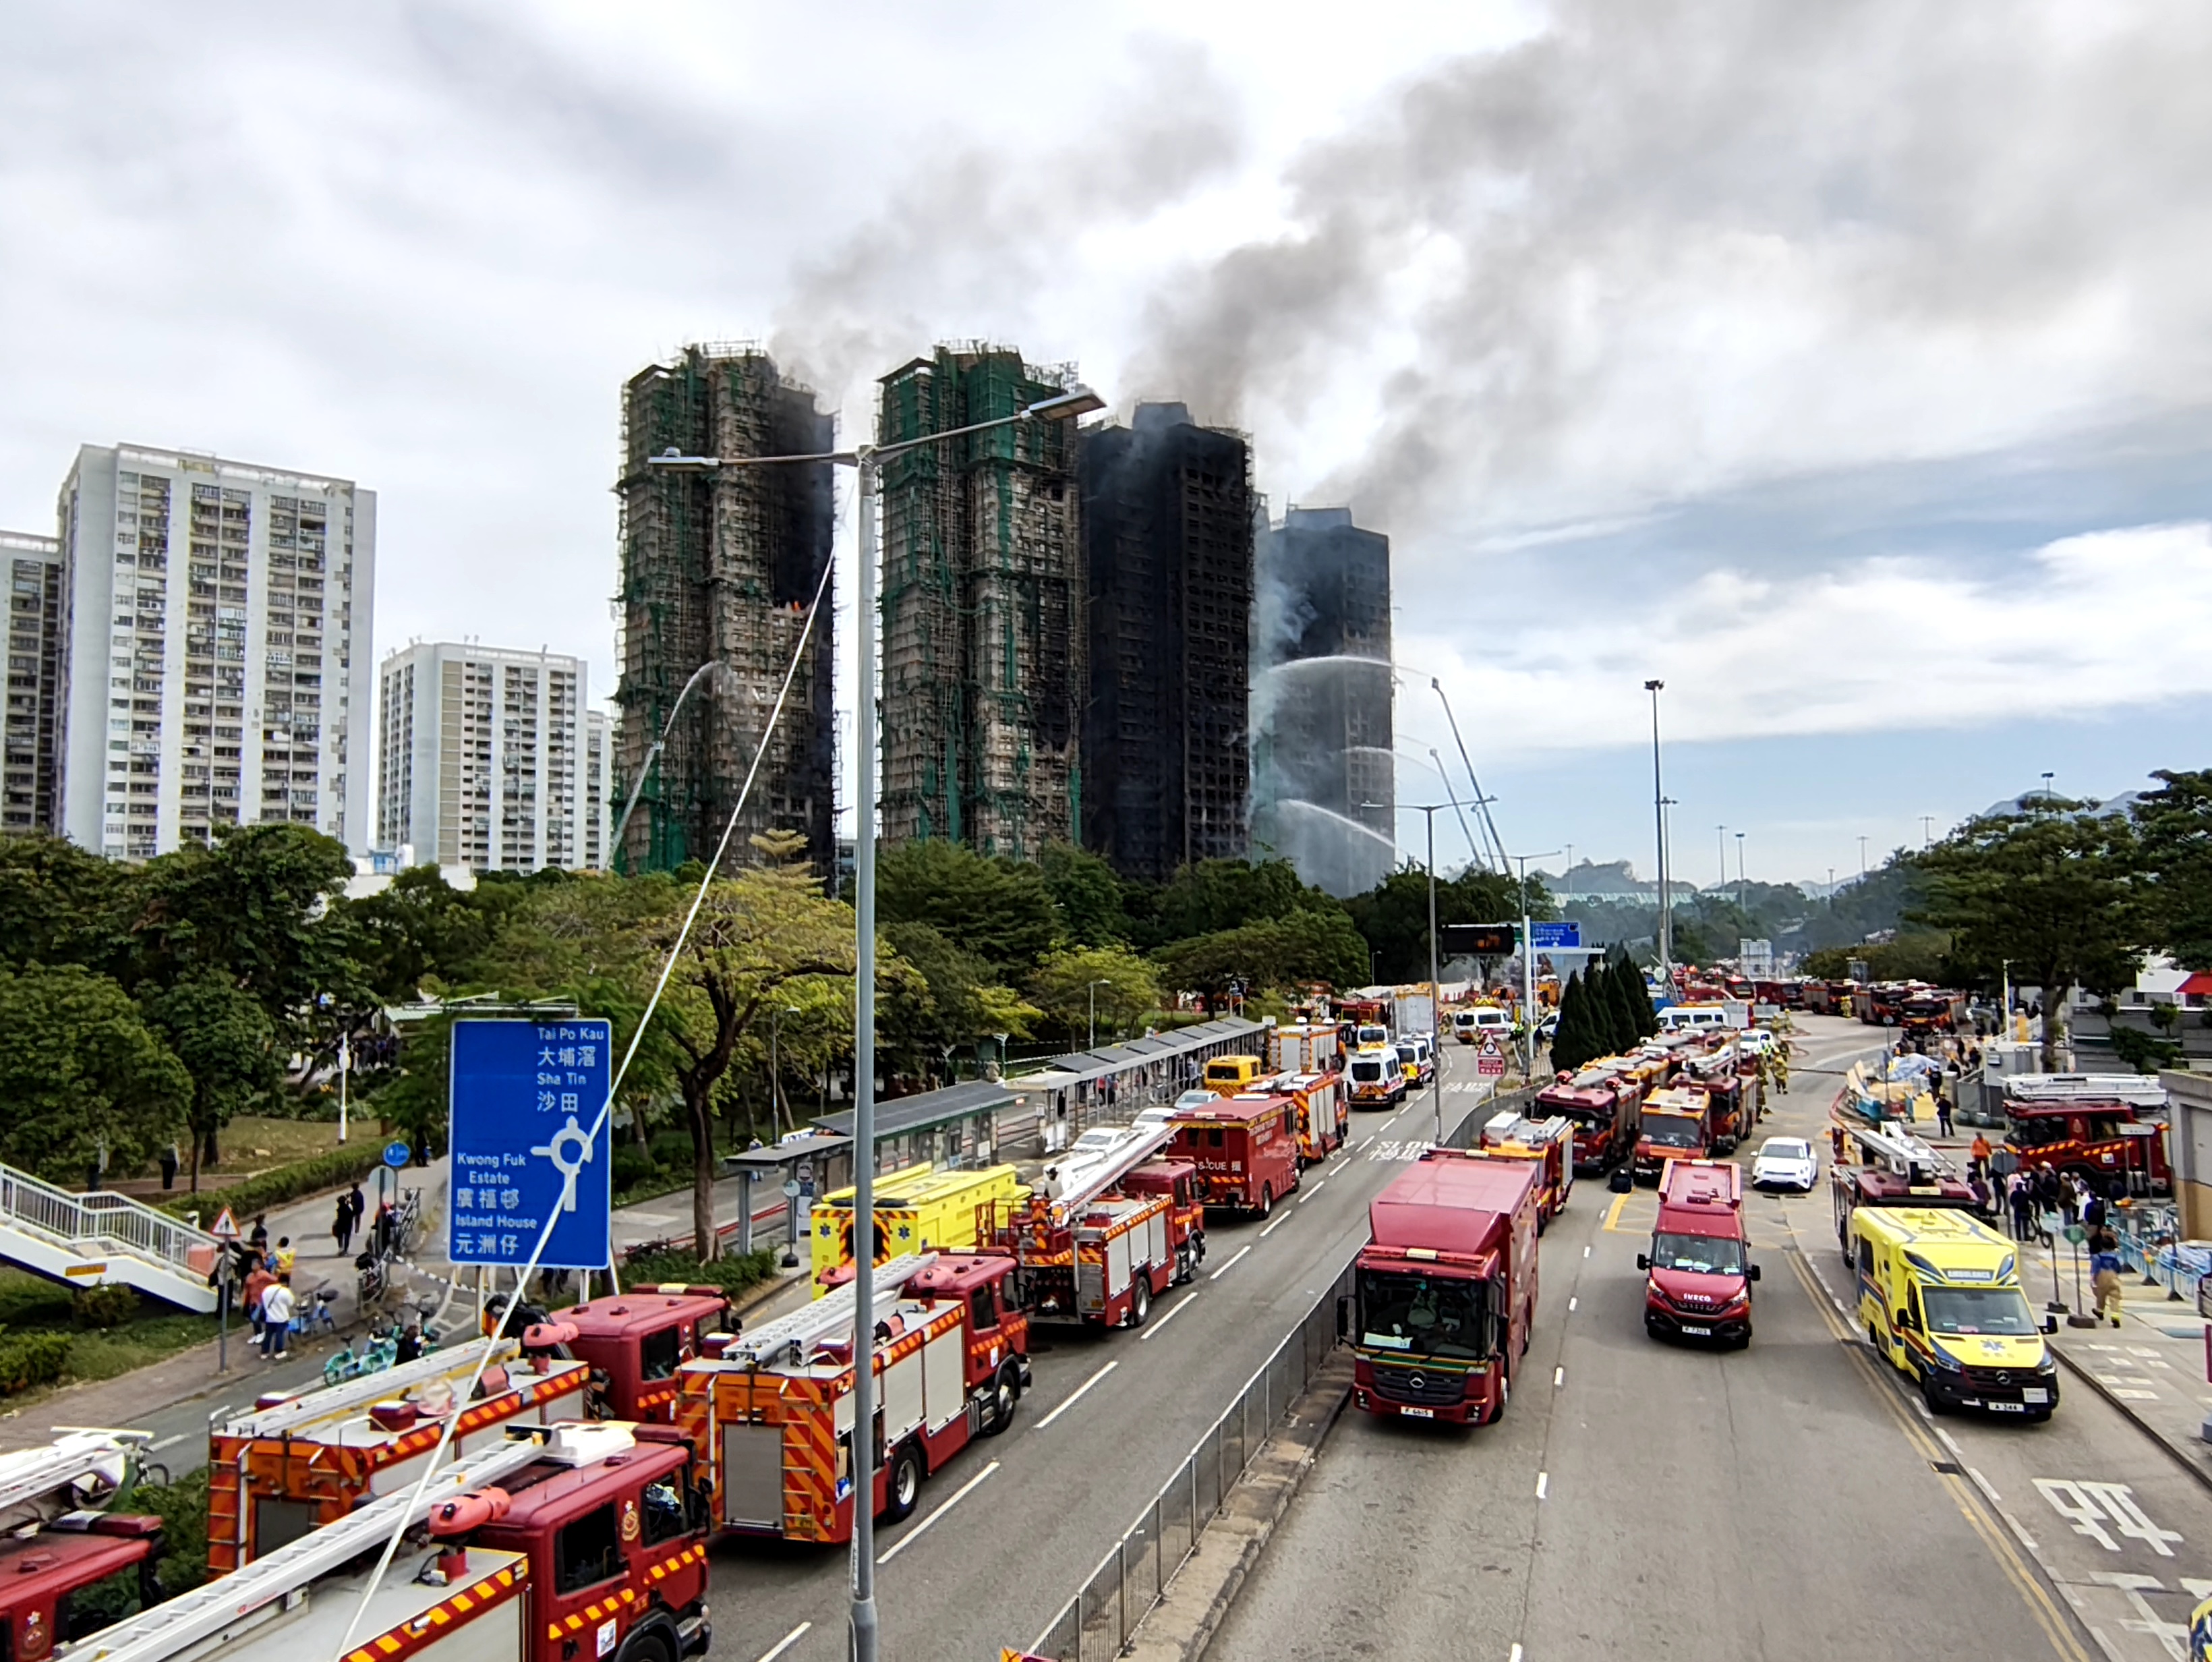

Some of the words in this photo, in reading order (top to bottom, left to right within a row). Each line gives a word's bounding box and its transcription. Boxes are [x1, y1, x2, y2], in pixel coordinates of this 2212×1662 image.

[538, 1028, 556, 1040] Tai
[560, 1028, 576, 1040] Po
[580, 1028, 604, 1041] Kau
[537, 1046, 596, 1068] 大埔滘
[537, 1072, 560, 1086] Sha
[566, 1072, 587, 1085] Tin
[537, 1090, 579, 1113] 沙田
[457, 1153, 500, 1168] Kwong
[503, 1153, 526, 1167] Fuk
[469, 1172, 511, 1184] Estate
[455, 1214, 494, 1228] Island
[496, 1215, 538, 1229] House
[455, 1233, 519, 1256] 元洲仔
[1683, 1293, 1712, 1302] IVECO
